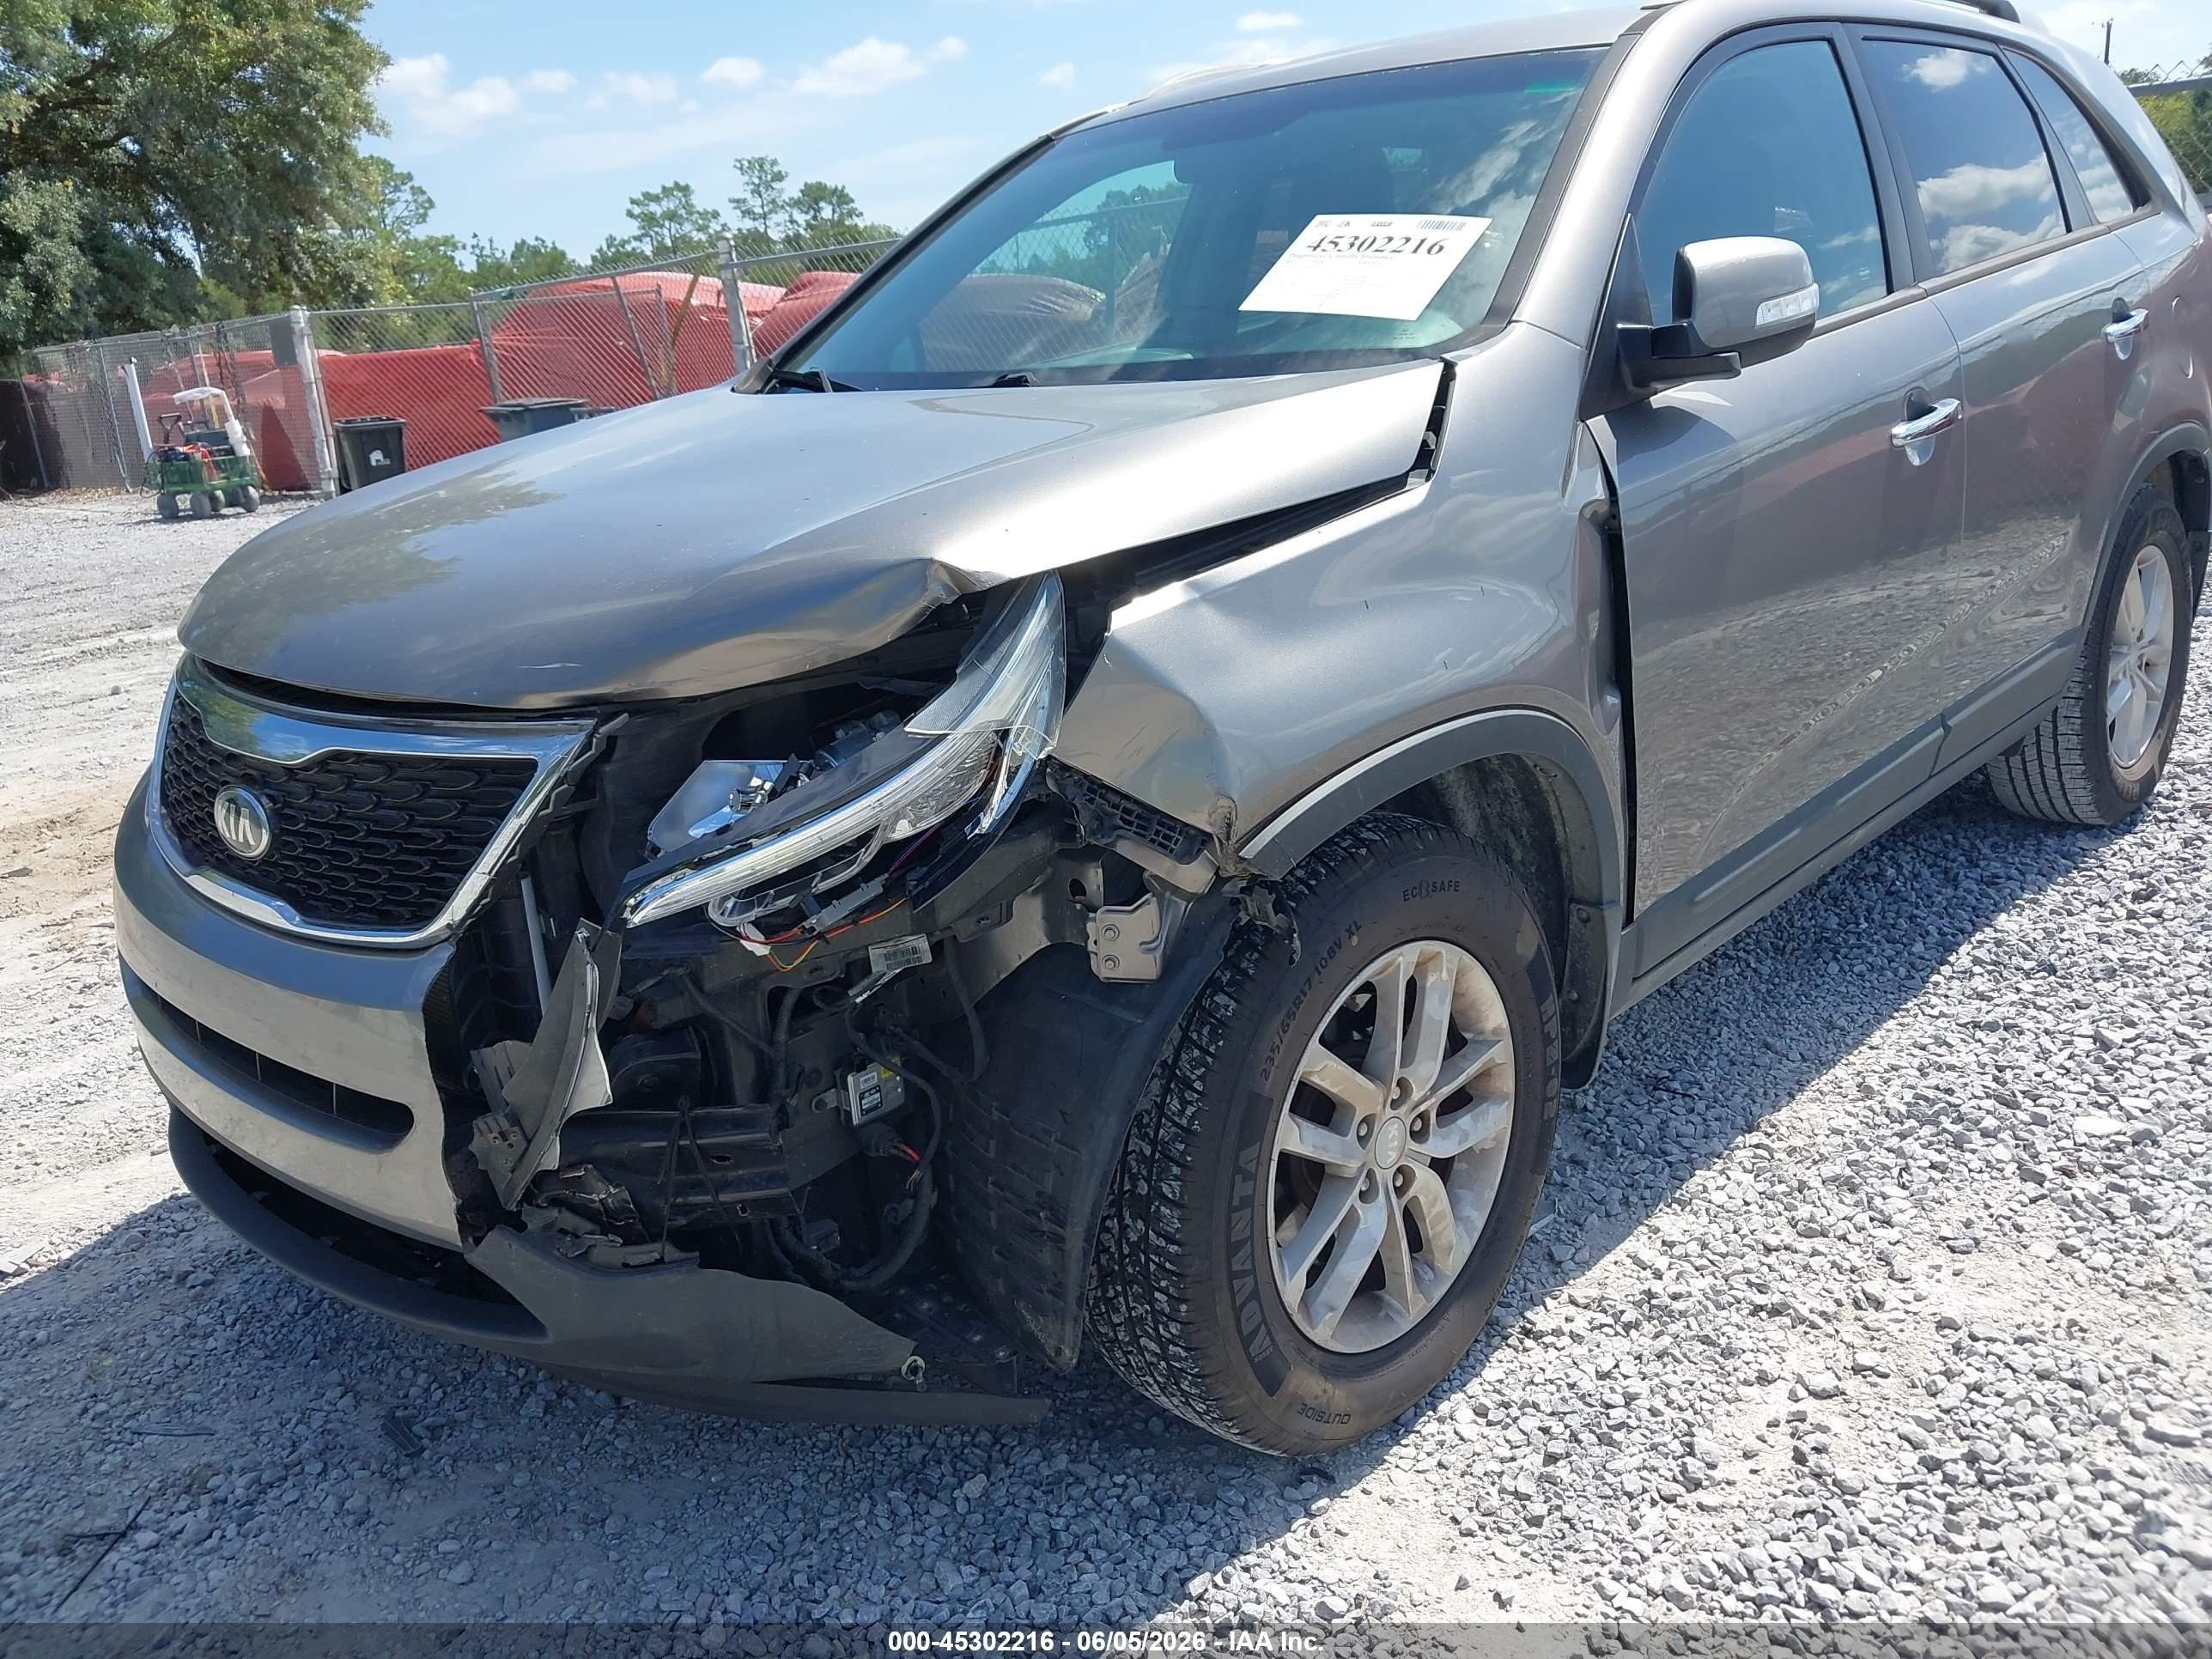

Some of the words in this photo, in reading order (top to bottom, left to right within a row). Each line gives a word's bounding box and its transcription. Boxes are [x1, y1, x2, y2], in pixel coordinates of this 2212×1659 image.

[1306, 234, 1449, 255] 45302216
[1260, 975, 1313, 1082] 235/65R17
[1345, 920, 1363, 939] XL
[1230, 1141, 1272, 1357] ADVANTA
[1296, 1401, 1352, 1425] OUTSIDE
